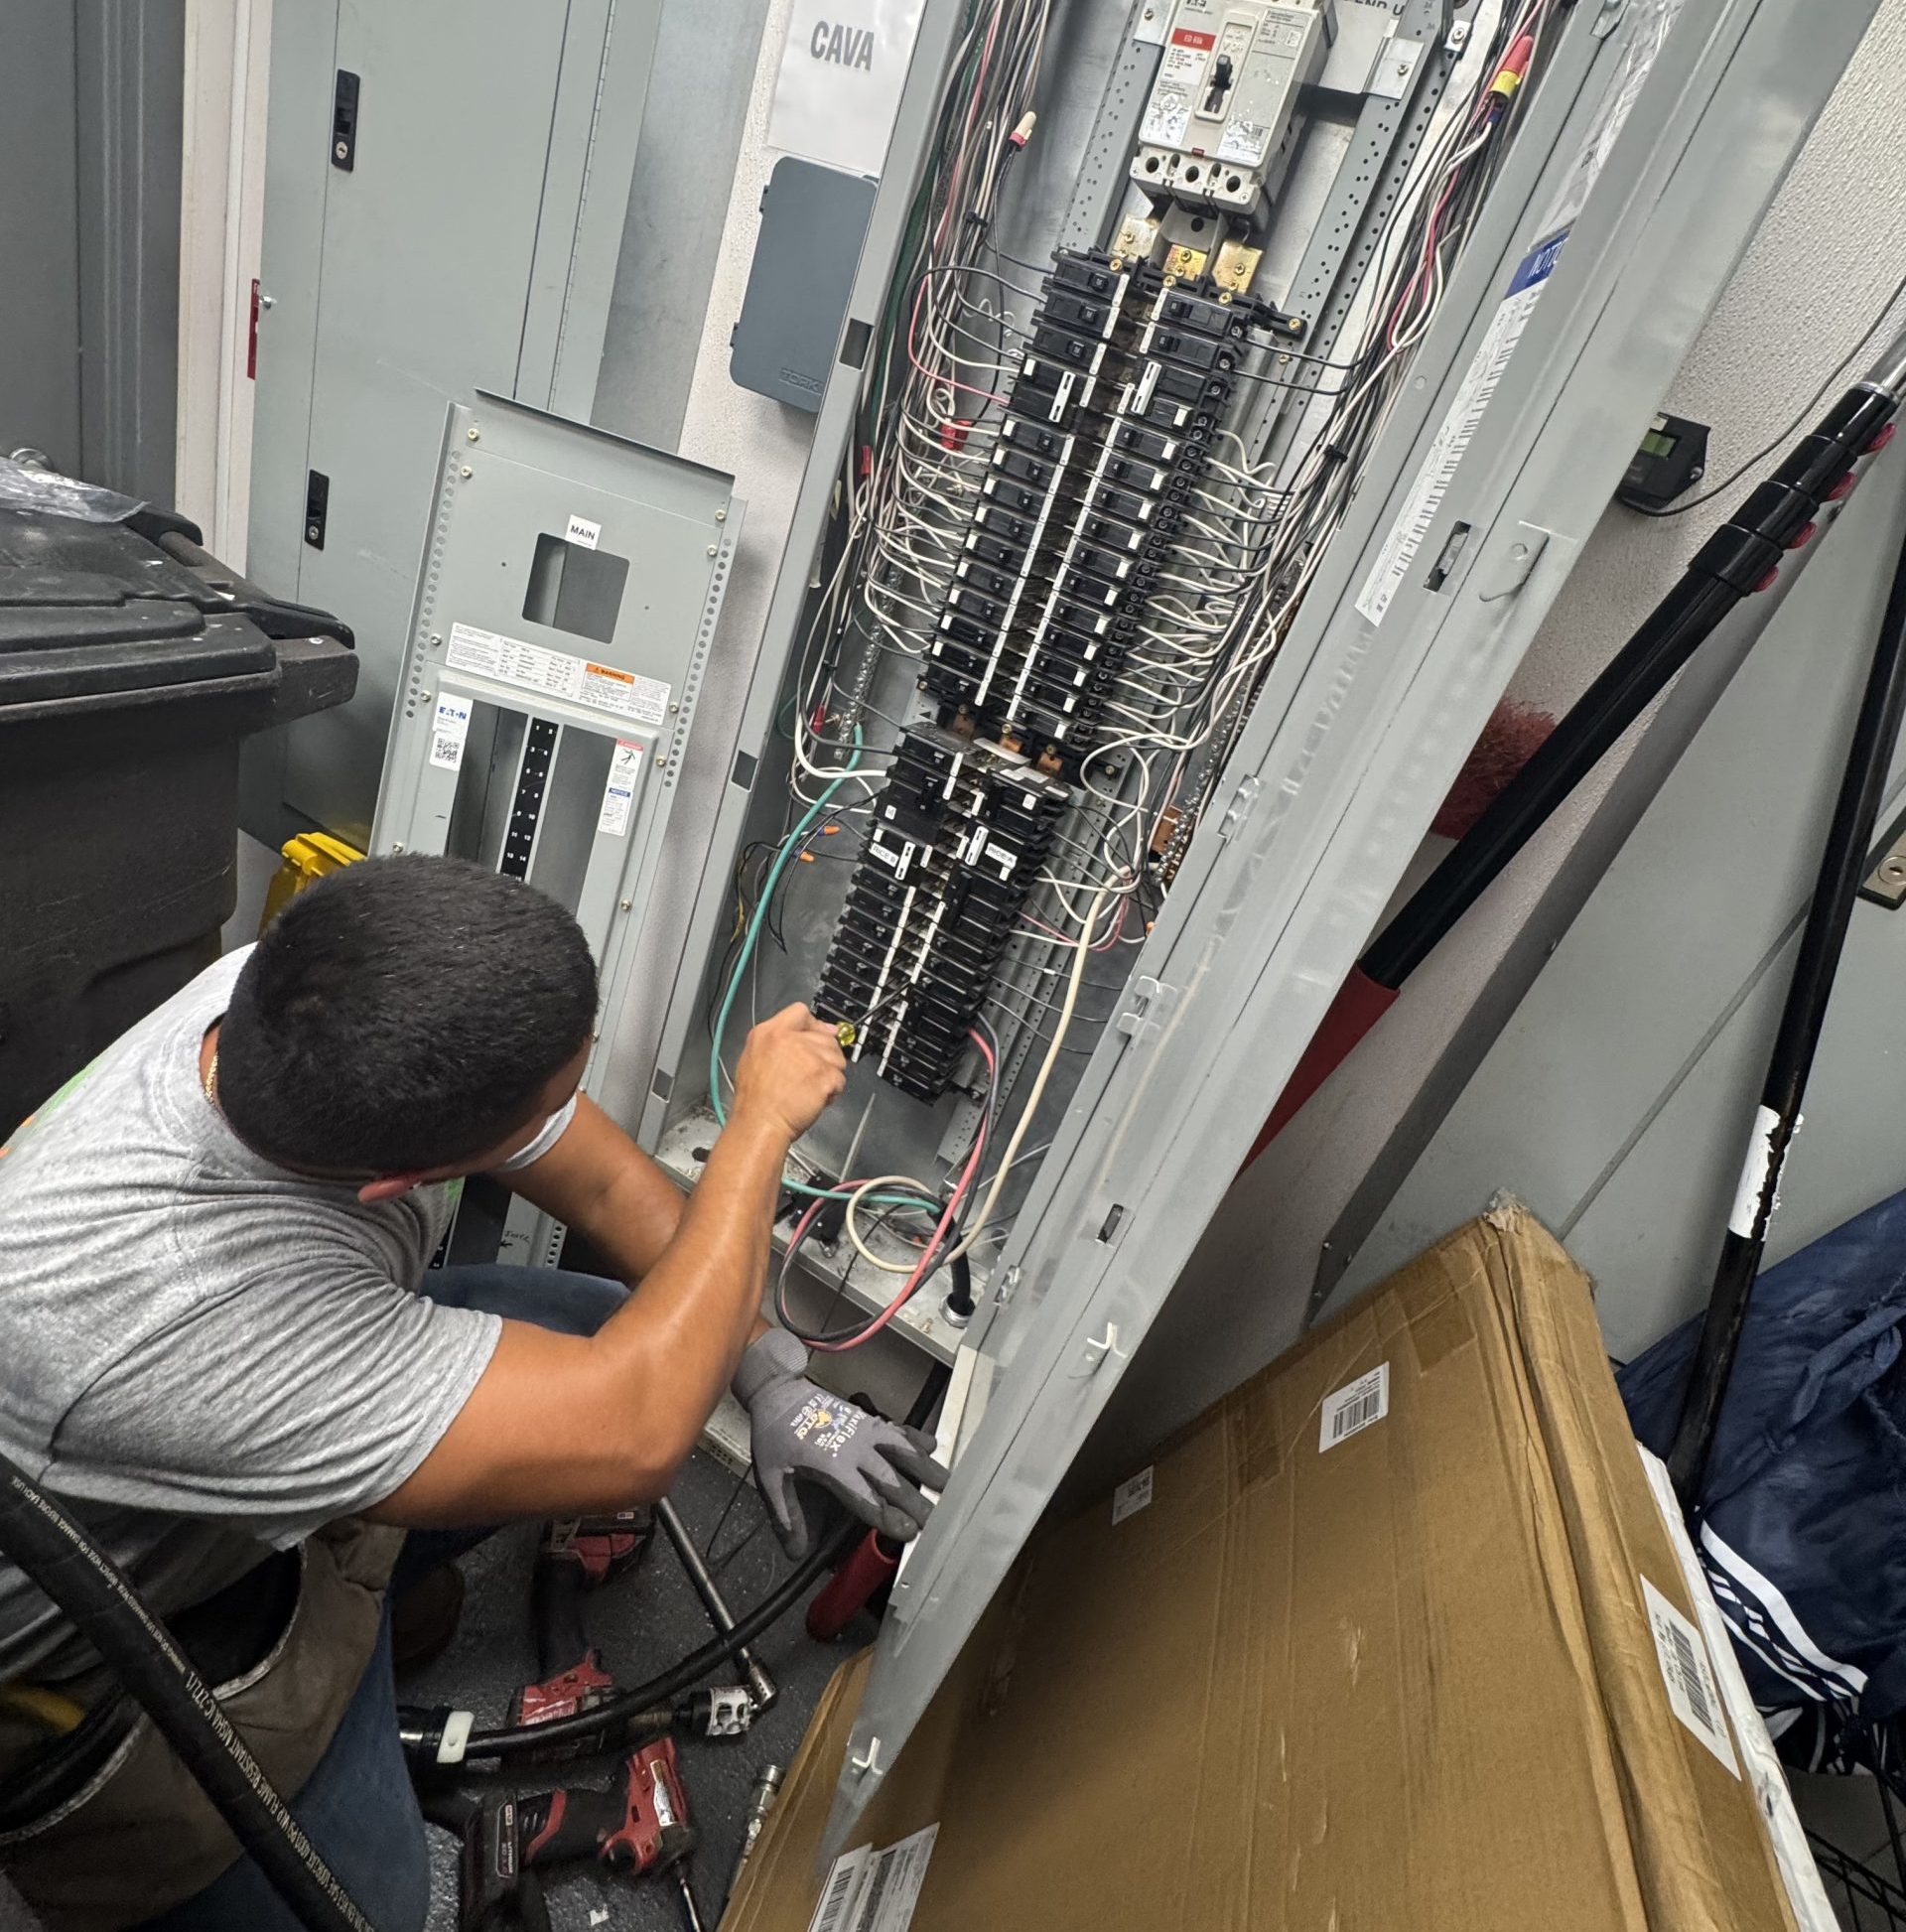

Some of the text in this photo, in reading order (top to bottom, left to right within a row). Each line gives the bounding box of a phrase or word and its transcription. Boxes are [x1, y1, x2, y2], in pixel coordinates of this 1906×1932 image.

[810, 20, 875, 71] CAVA
[1527, 236, 1568, 279] NOTIC
[779, 367, 821, 392] TORK
[570, 524, 596, 540] MAIN
[228, 1736, 262, 1789] RESISTANT
